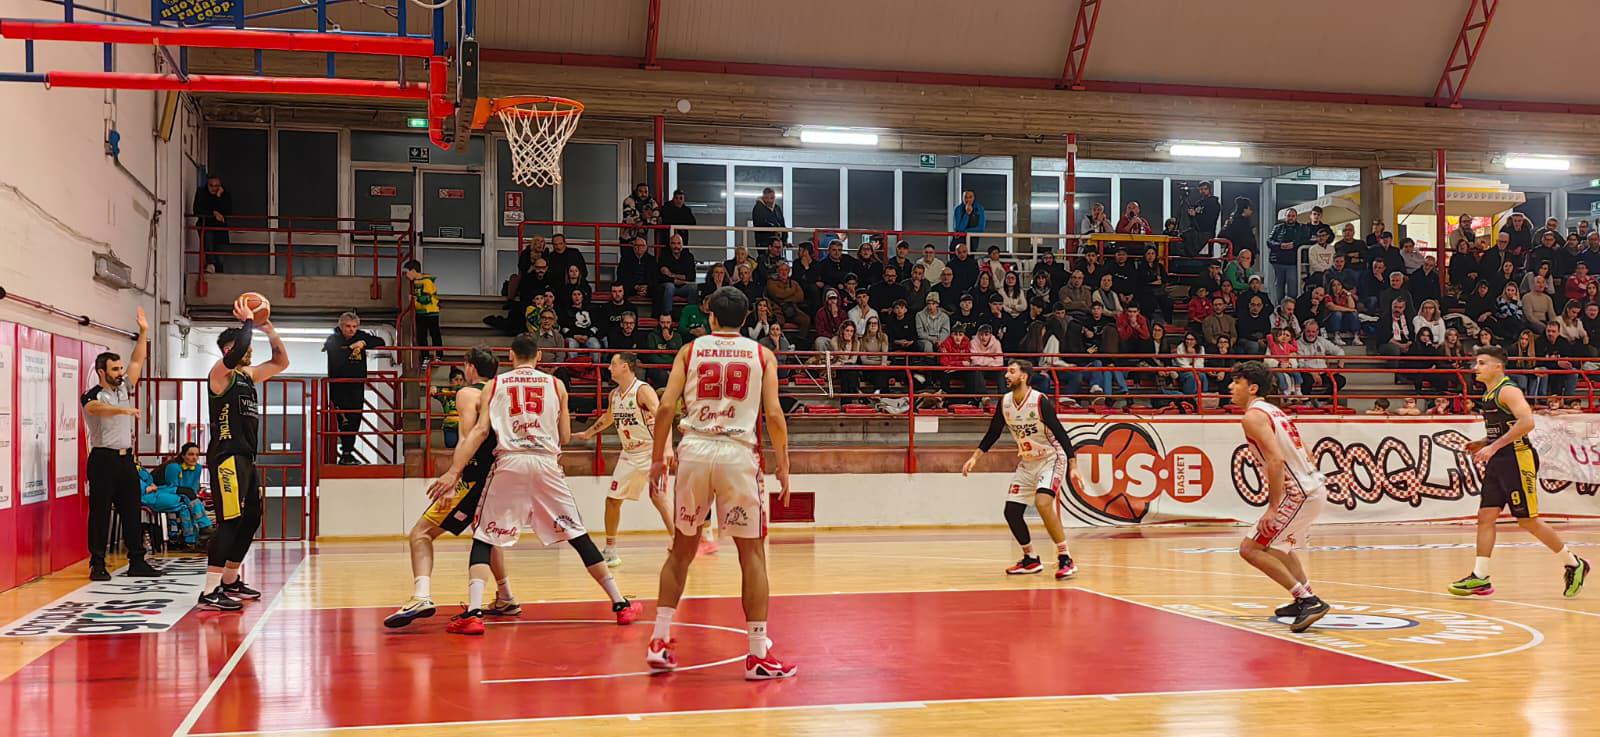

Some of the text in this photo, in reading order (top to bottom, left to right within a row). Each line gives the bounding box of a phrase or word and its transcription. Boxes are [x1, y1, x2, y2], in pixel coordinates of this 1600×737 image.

[161, 0, 202, 18] nuov
[197, 2, 235, 20] coop.
[696, 361, 752, 402] 28
[507, 385, 545, 418] 15
[1176, 455, 1185, 495] BASKET
[1511, 490, 1521, 506] 9
